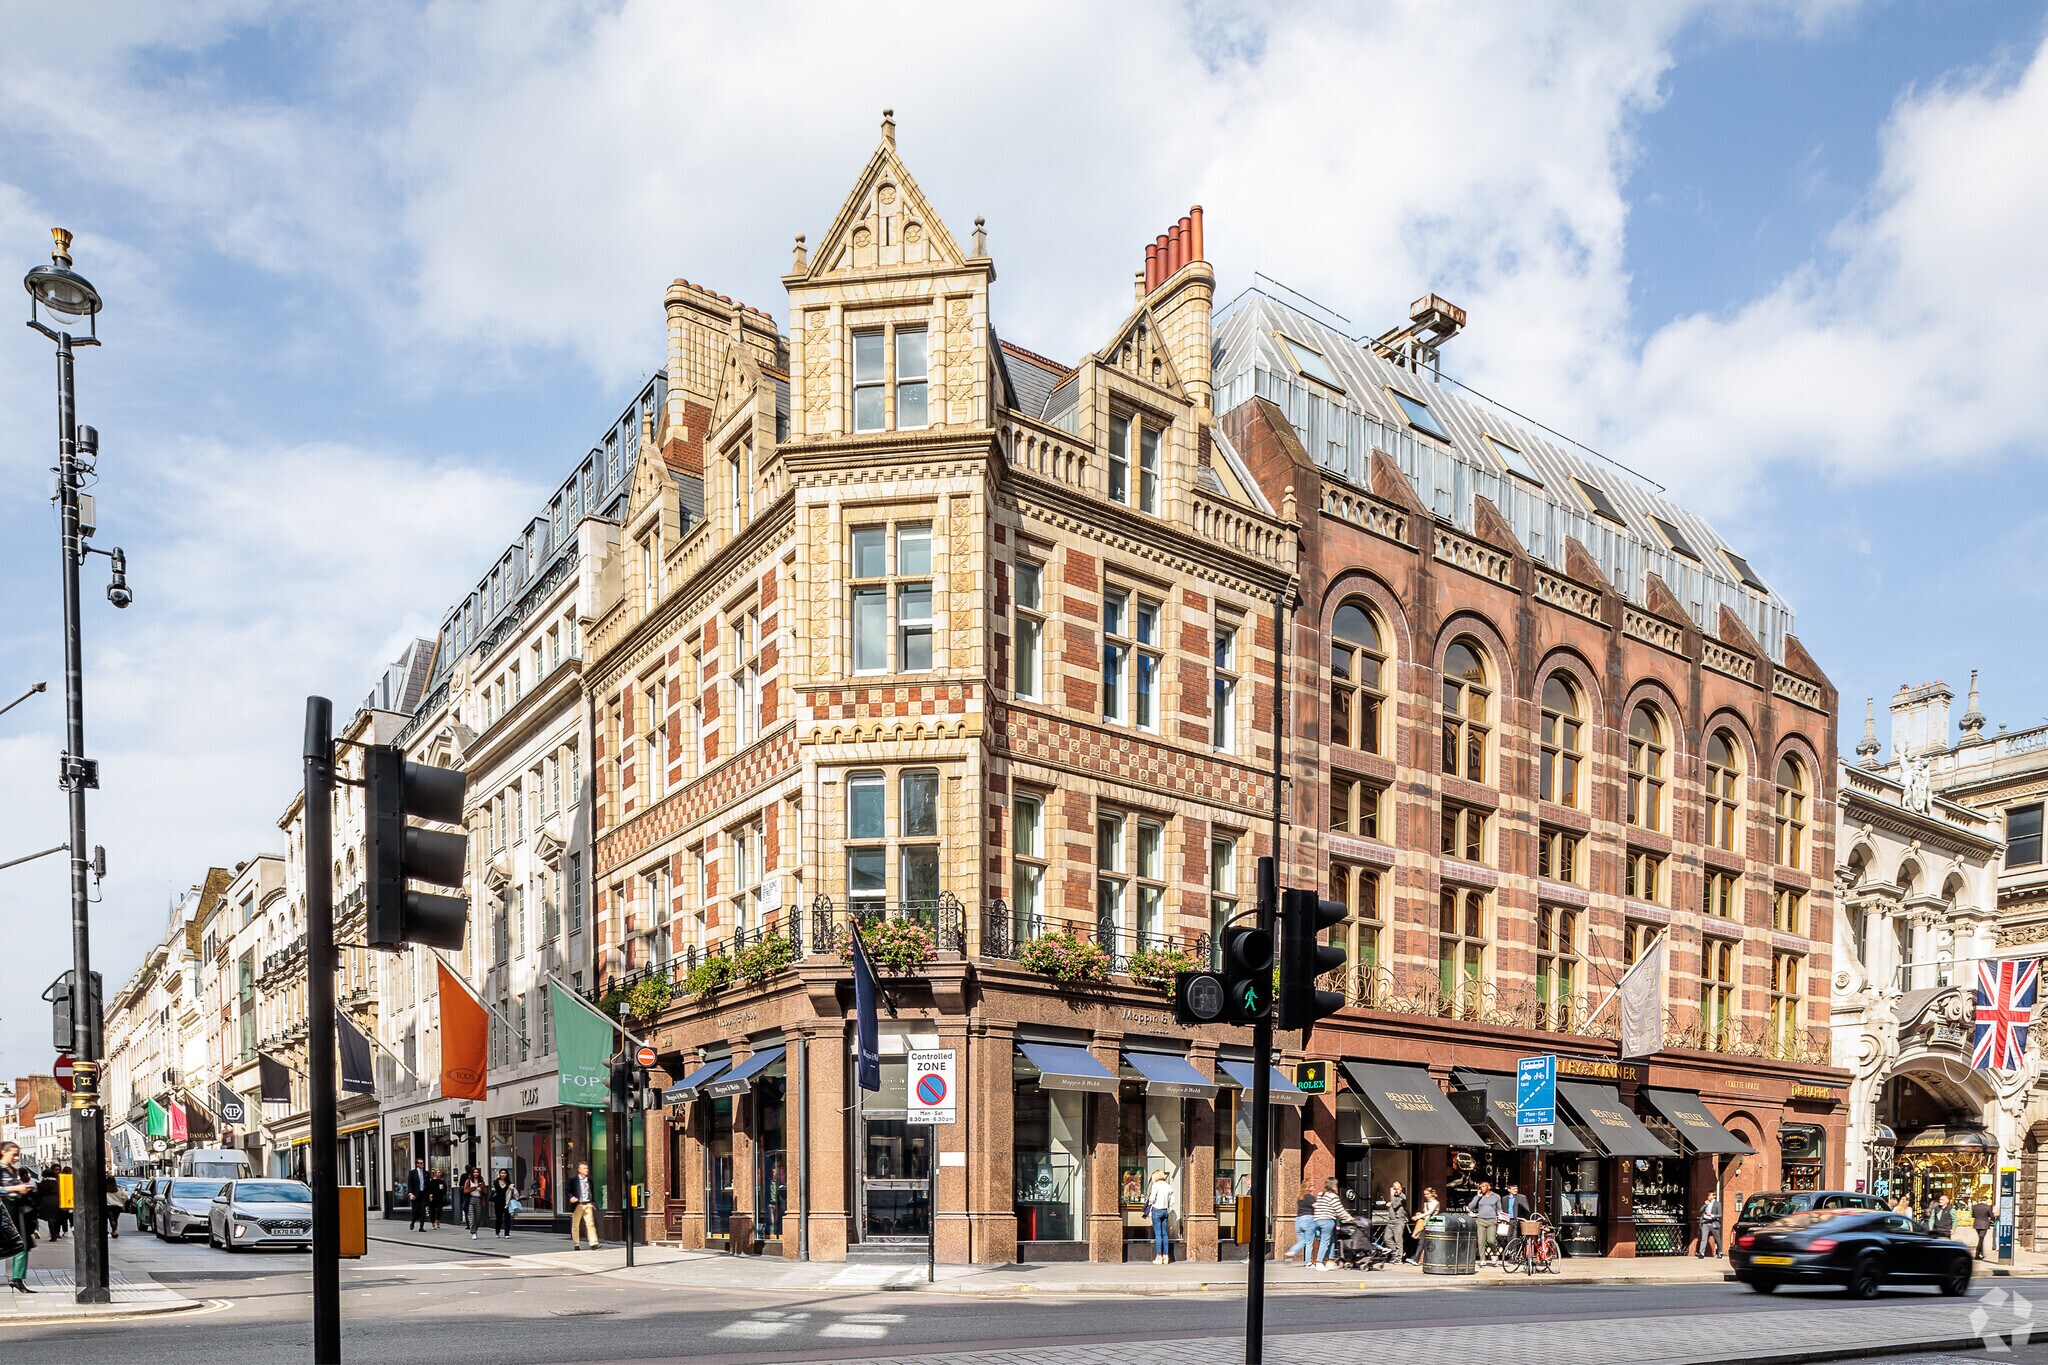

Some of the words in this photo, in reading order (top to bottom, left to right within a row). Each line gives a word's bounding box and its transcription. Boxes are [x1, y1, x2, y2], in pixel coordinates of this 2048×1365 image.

[1122, 1008, 1158, 1025] Mappin
[911, 1052, 953, 1061] Controlled
[917, 1062, 947, 1071] ZONE
[1556, 1059, 1582, 1075] TLEY
[1587, 1062, 1637, 1081] SKINNER
[562, 1073, 606, 1087] FOP
[1061, 1078, 1081, 1087] Mappin
[1297, 1080, 1325, 1090] ROLEX
[1165, 1086, 1183, 1094] Mappin
[1725, 1080, 1745, 1090] COLETTE
[1745, 1081, 1760, 1091] HOUSE
[1385, 1091, 1429, 1104] BENTLEY
[1400, 1102, 1438, 1112] SKINNER
[81, 1108, 96, 1117] 67
[1590, 1108, 1624, 1121] BENTLEY
[1674, 1110, 1704, 1121] BENTLEY
[1602, 1117, 1632, 1128] SKINNER
[1686, 1119, 1713, 1129] SKINNER
